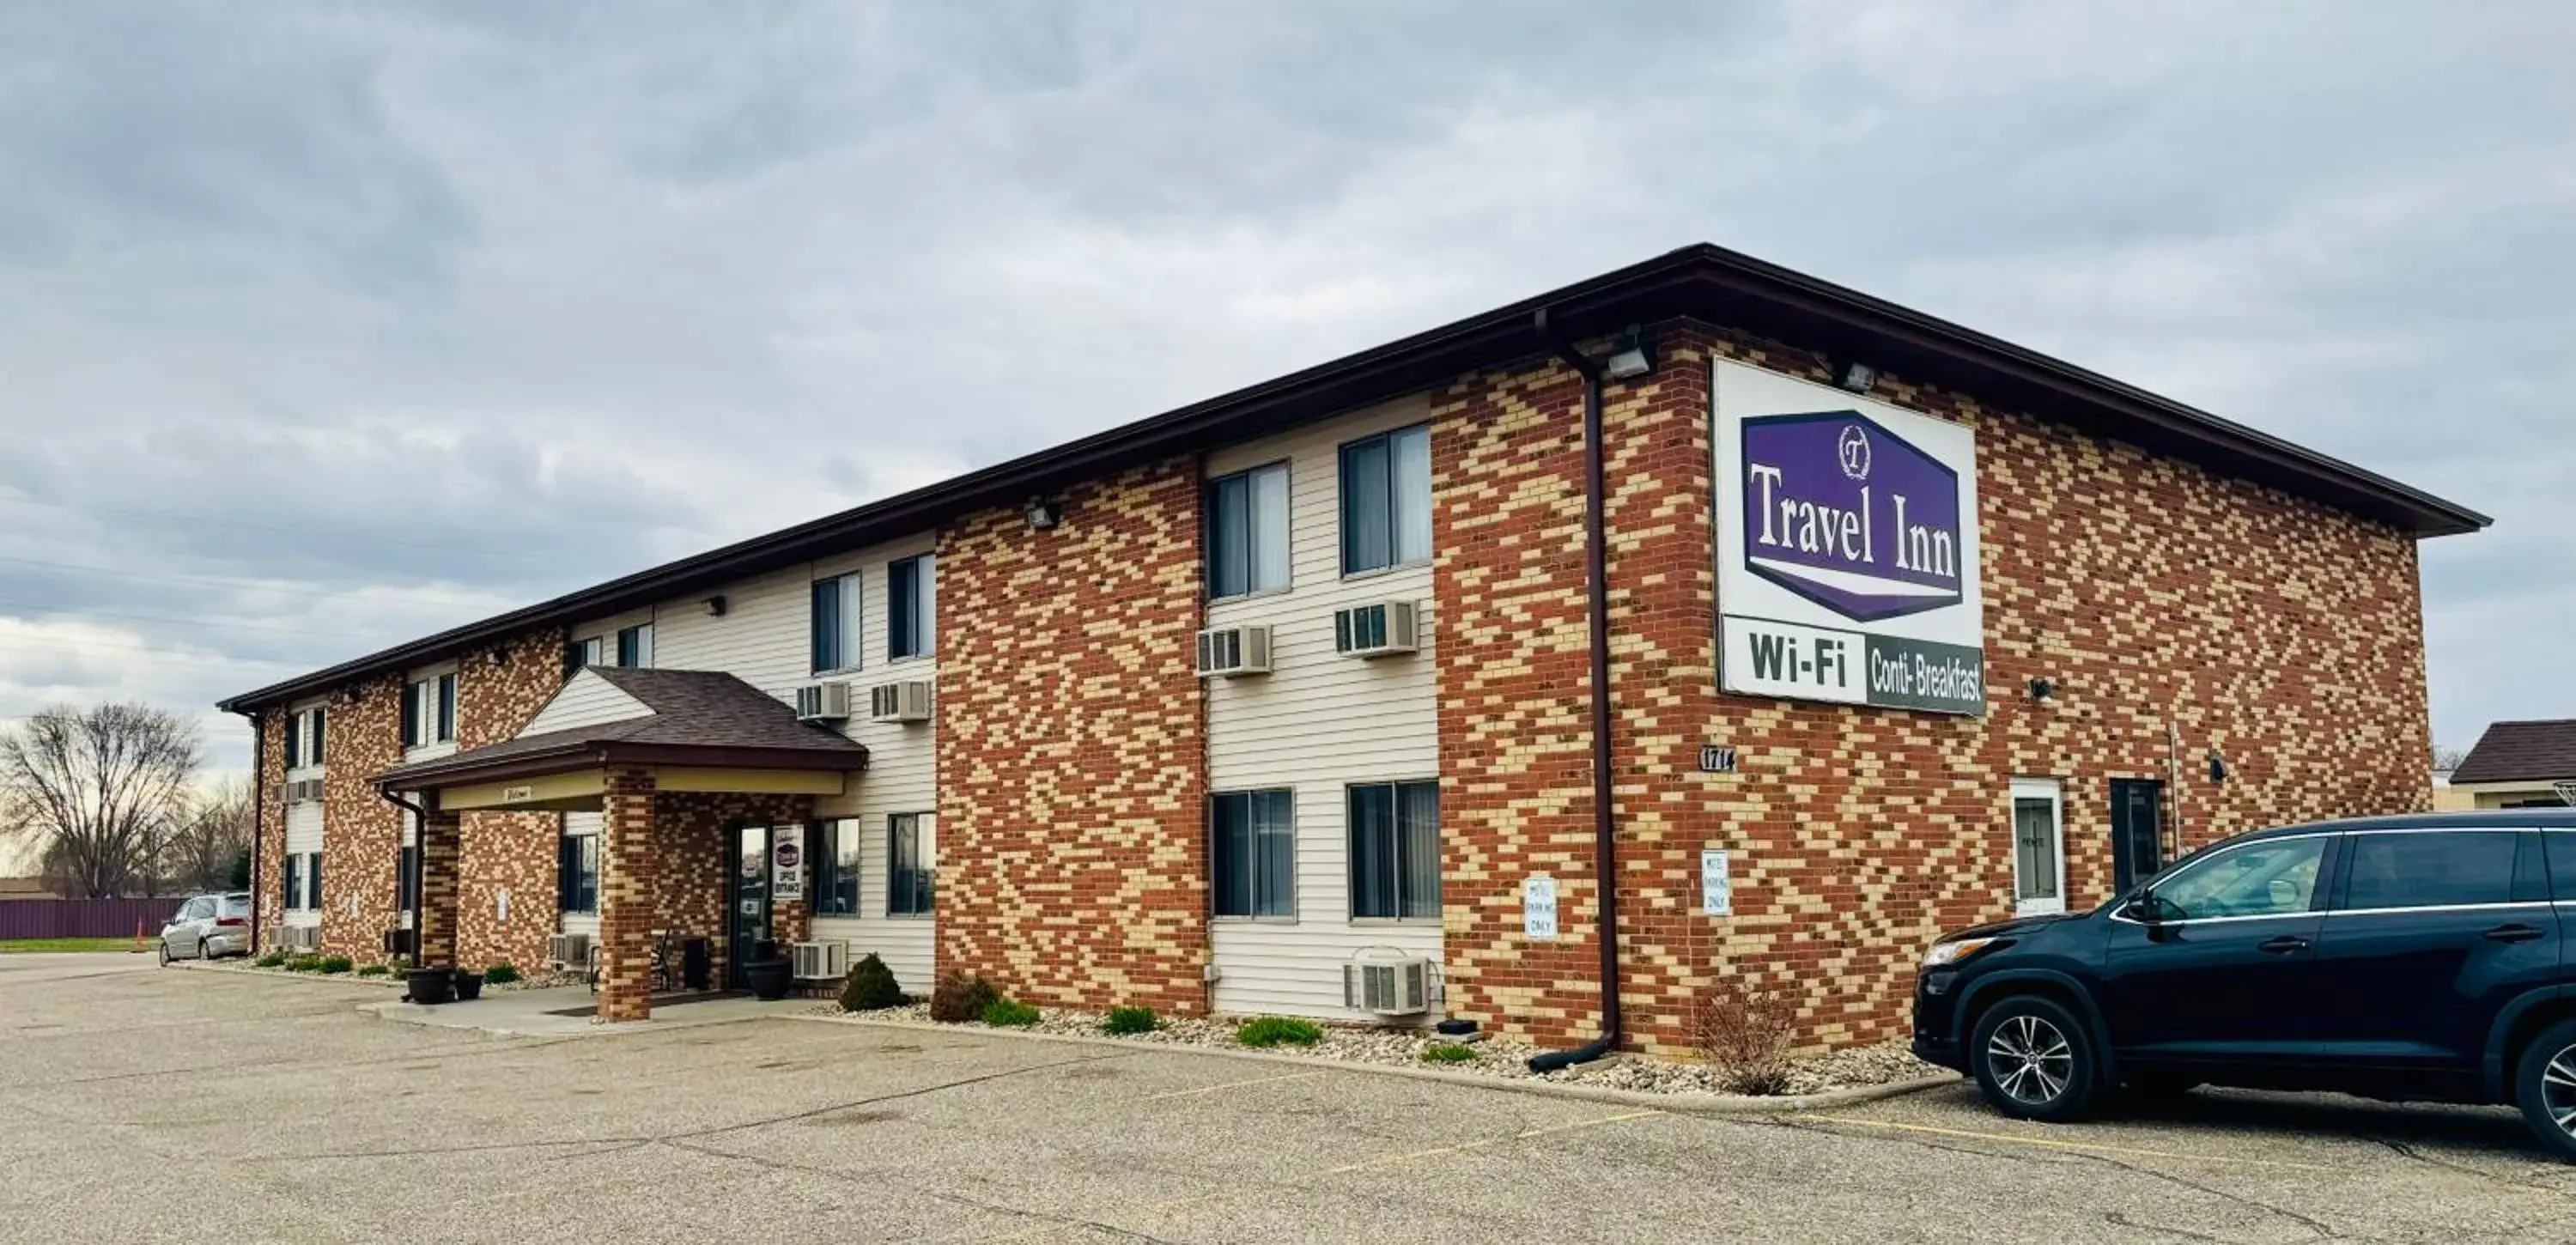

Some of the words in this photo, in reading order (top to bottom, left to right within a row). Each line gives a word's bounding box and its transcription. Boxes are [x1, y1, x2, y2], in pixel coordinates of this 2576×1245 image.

[1845, 439, 1862, 469] T
[1750, 463, 1874, 564] Travel
[1893, 494, 1955, 578] Inn
[1749, 632, 1846, 688] Wi-Fi
[1871, 647, 1914, 695] Conti-
[1916, 653, 1981, 701] Breakfast
[1704, 749, 1735, 770] 1714
[1530, 920, 1552, 932] ONLY
